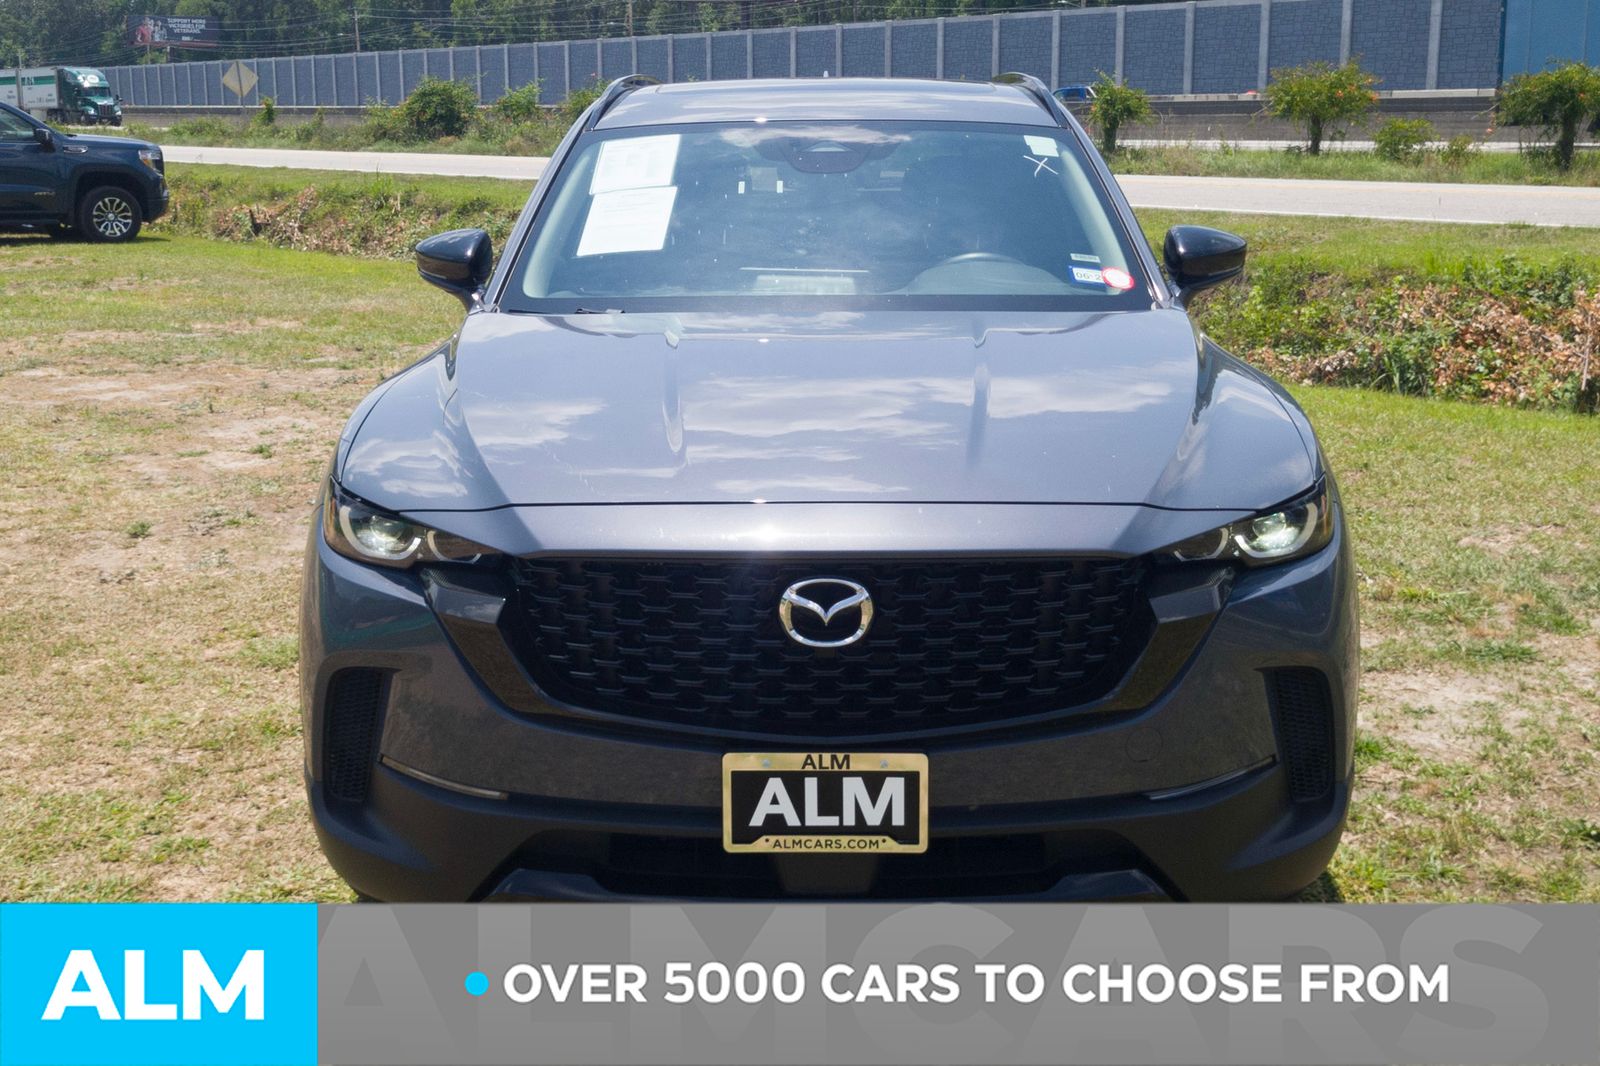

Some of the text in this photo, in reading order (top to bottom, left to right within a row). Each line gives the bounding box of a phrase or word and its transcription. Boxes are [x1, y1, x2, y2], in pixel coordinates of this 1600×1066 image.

[801, 754, 850, 769] ALM
[749, 777, 905, 826] ALM
[772, 839, 880, 849] ALMCARS.COM
